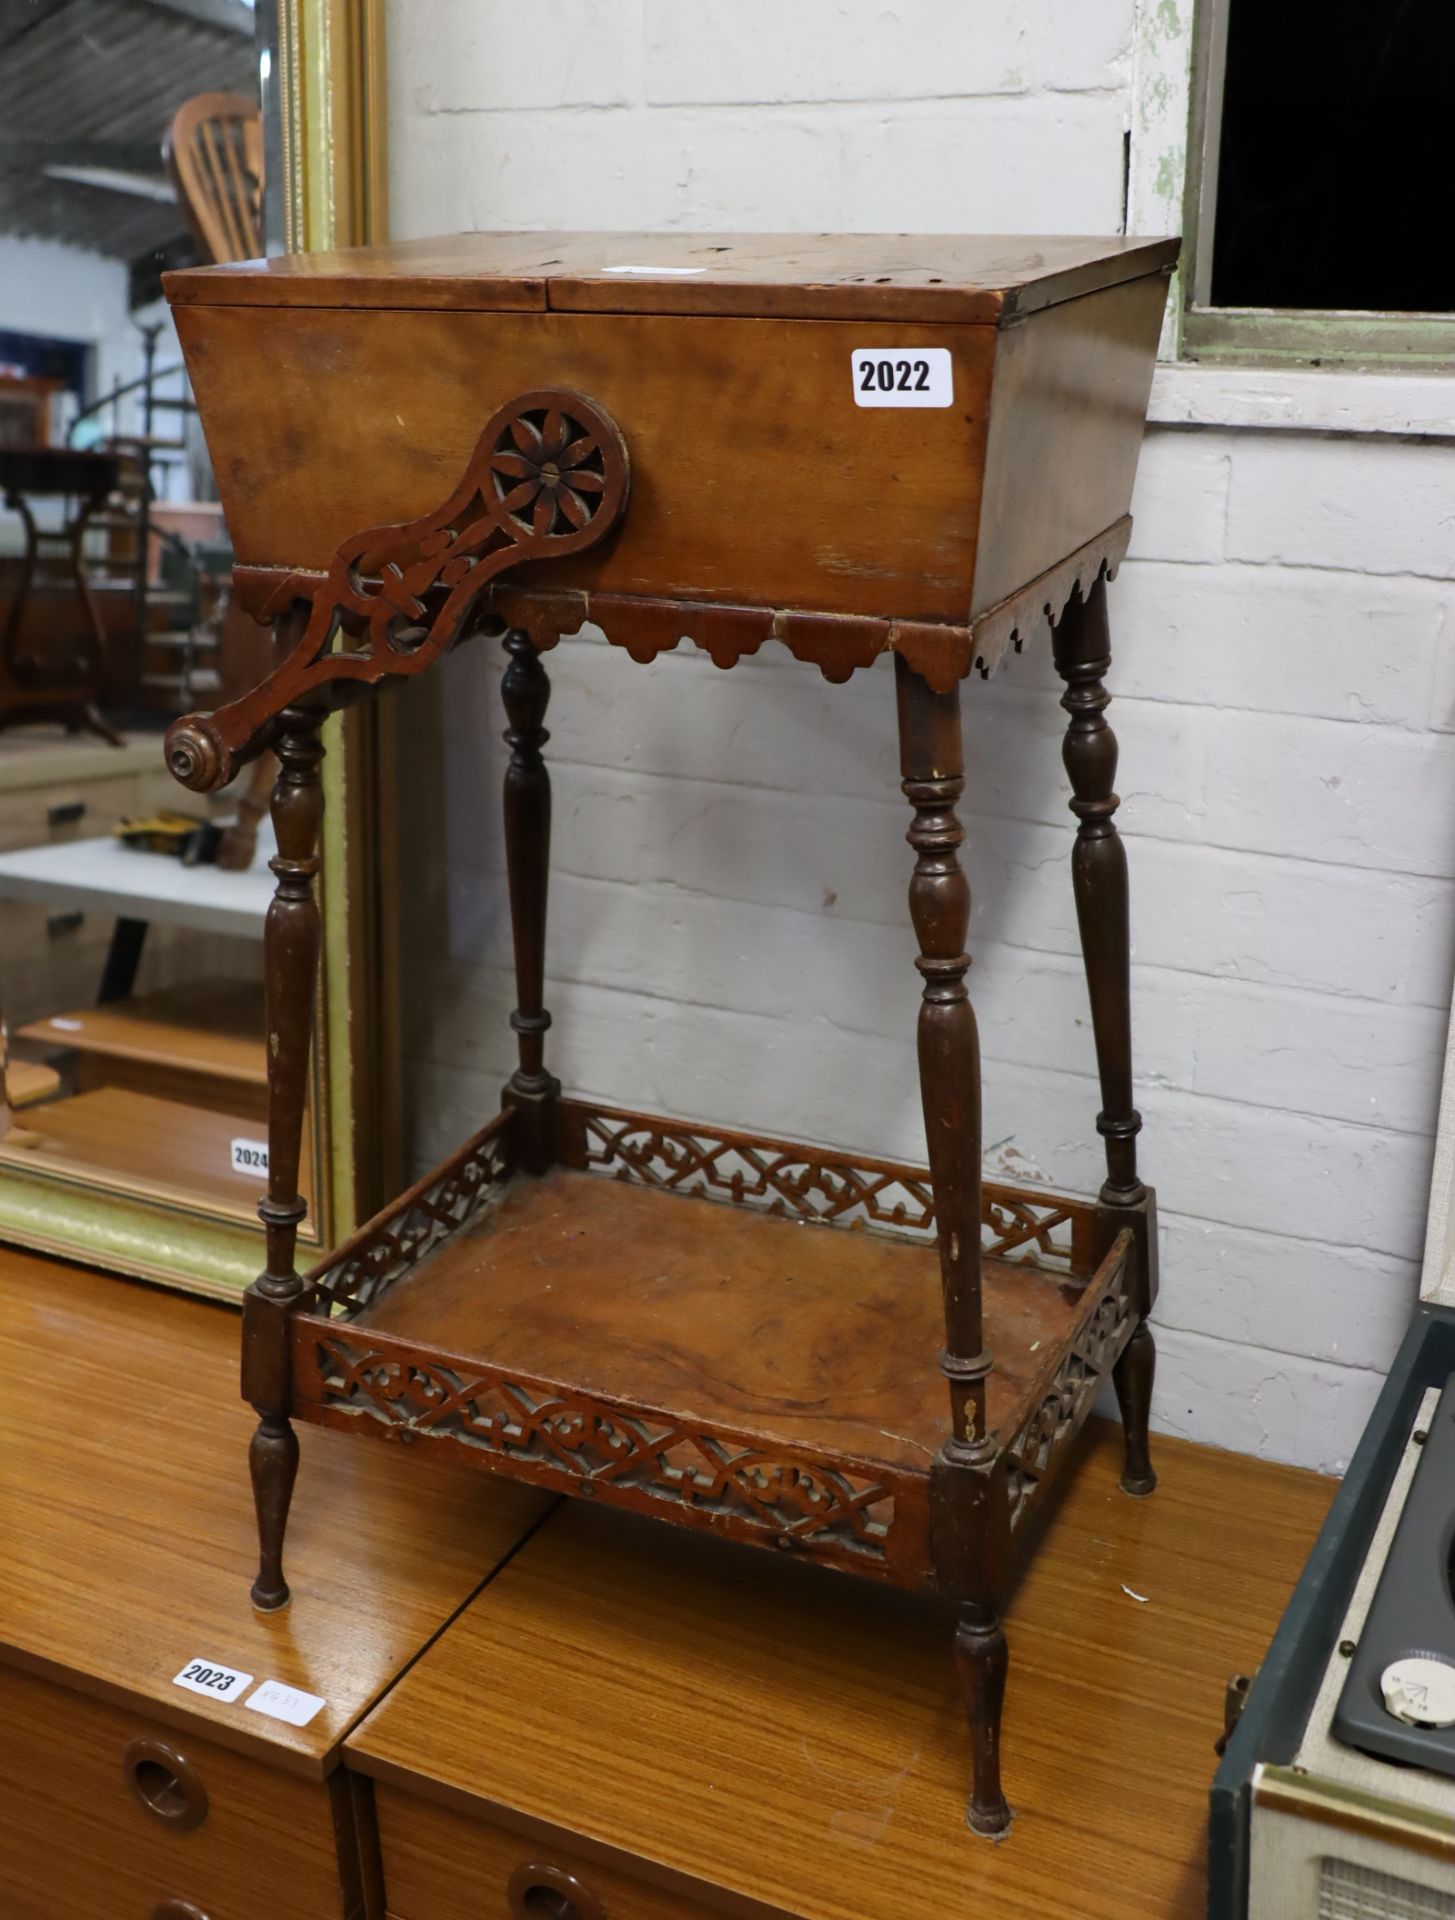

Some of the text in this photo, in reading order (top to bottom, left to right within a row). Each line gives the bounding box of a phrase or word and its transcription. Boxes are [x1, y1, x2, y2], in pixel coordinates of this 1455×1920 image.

[859, 360, 930, 392] 2022
[235, 1147, 268, 1169] 2024
[182, 1664, 236, 1691] 2023
